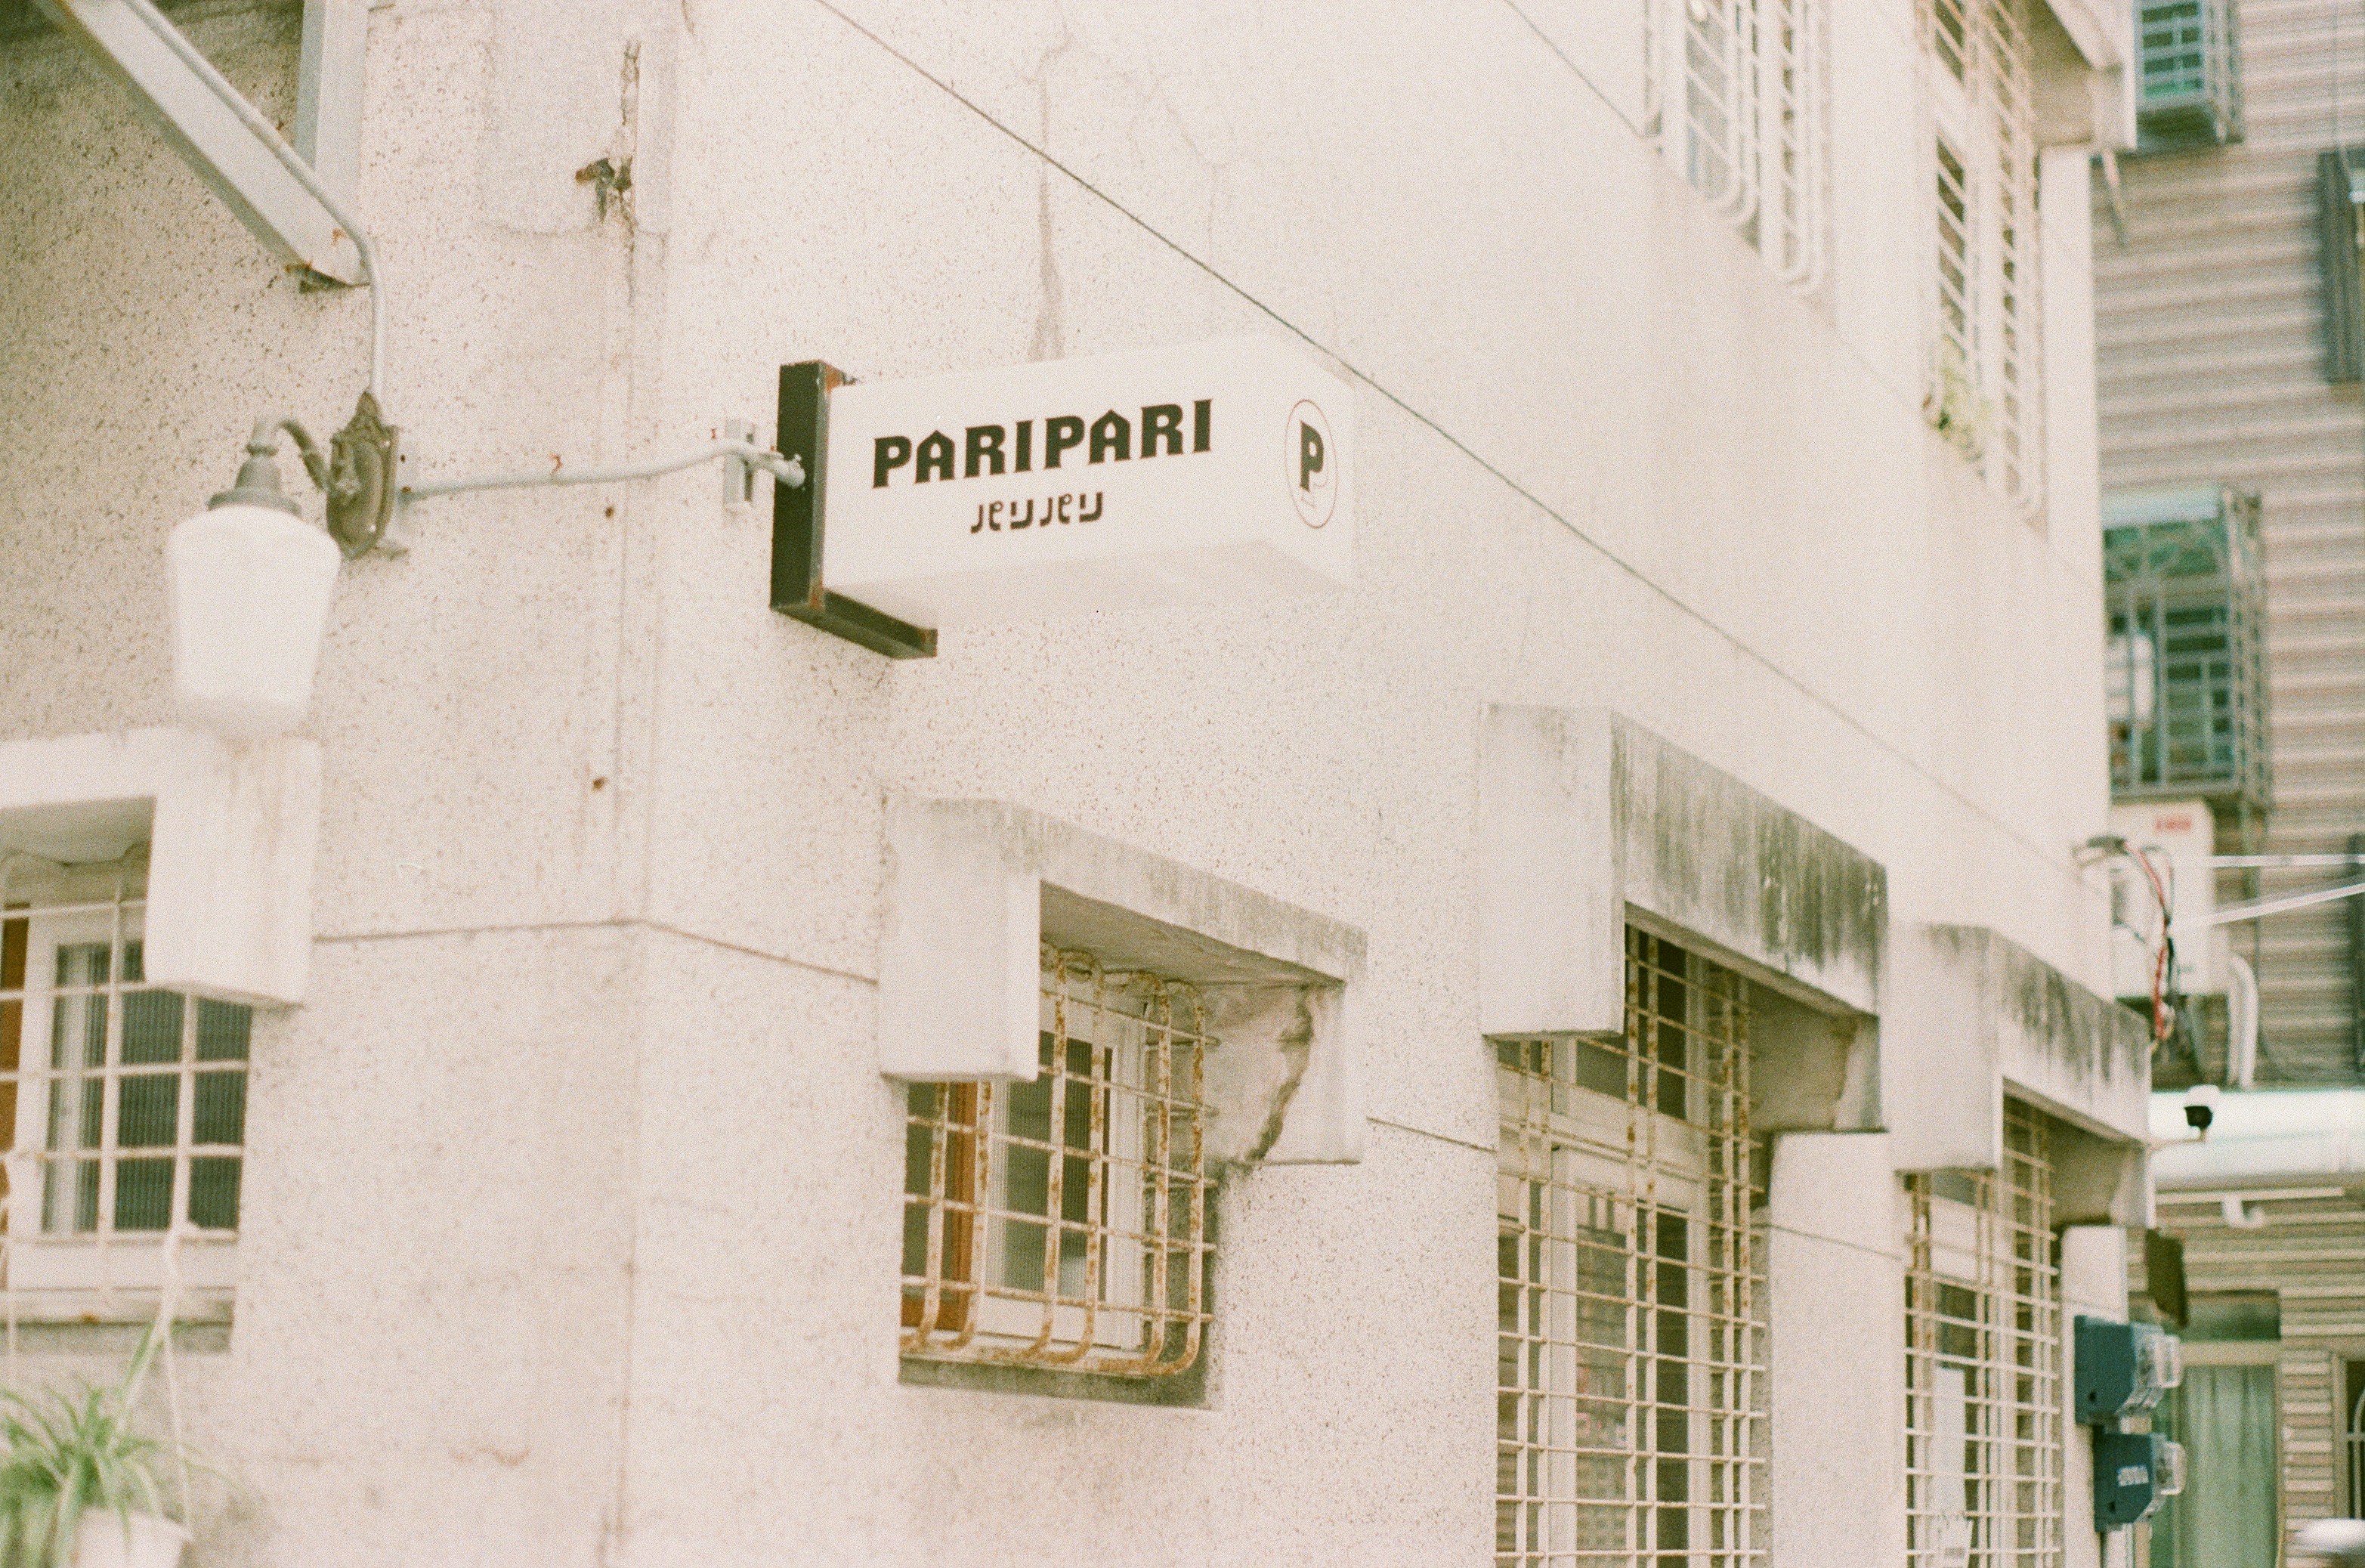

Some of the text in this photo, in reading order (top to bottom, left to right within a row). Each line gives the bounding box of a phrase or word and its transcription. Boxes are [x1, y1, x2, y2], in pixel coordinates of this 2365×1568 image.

[872, 398, 1213, 489] PARIPARI
[1300, 422, 1325, 492] P
[970, 491, 1103, 534] パリパリ
